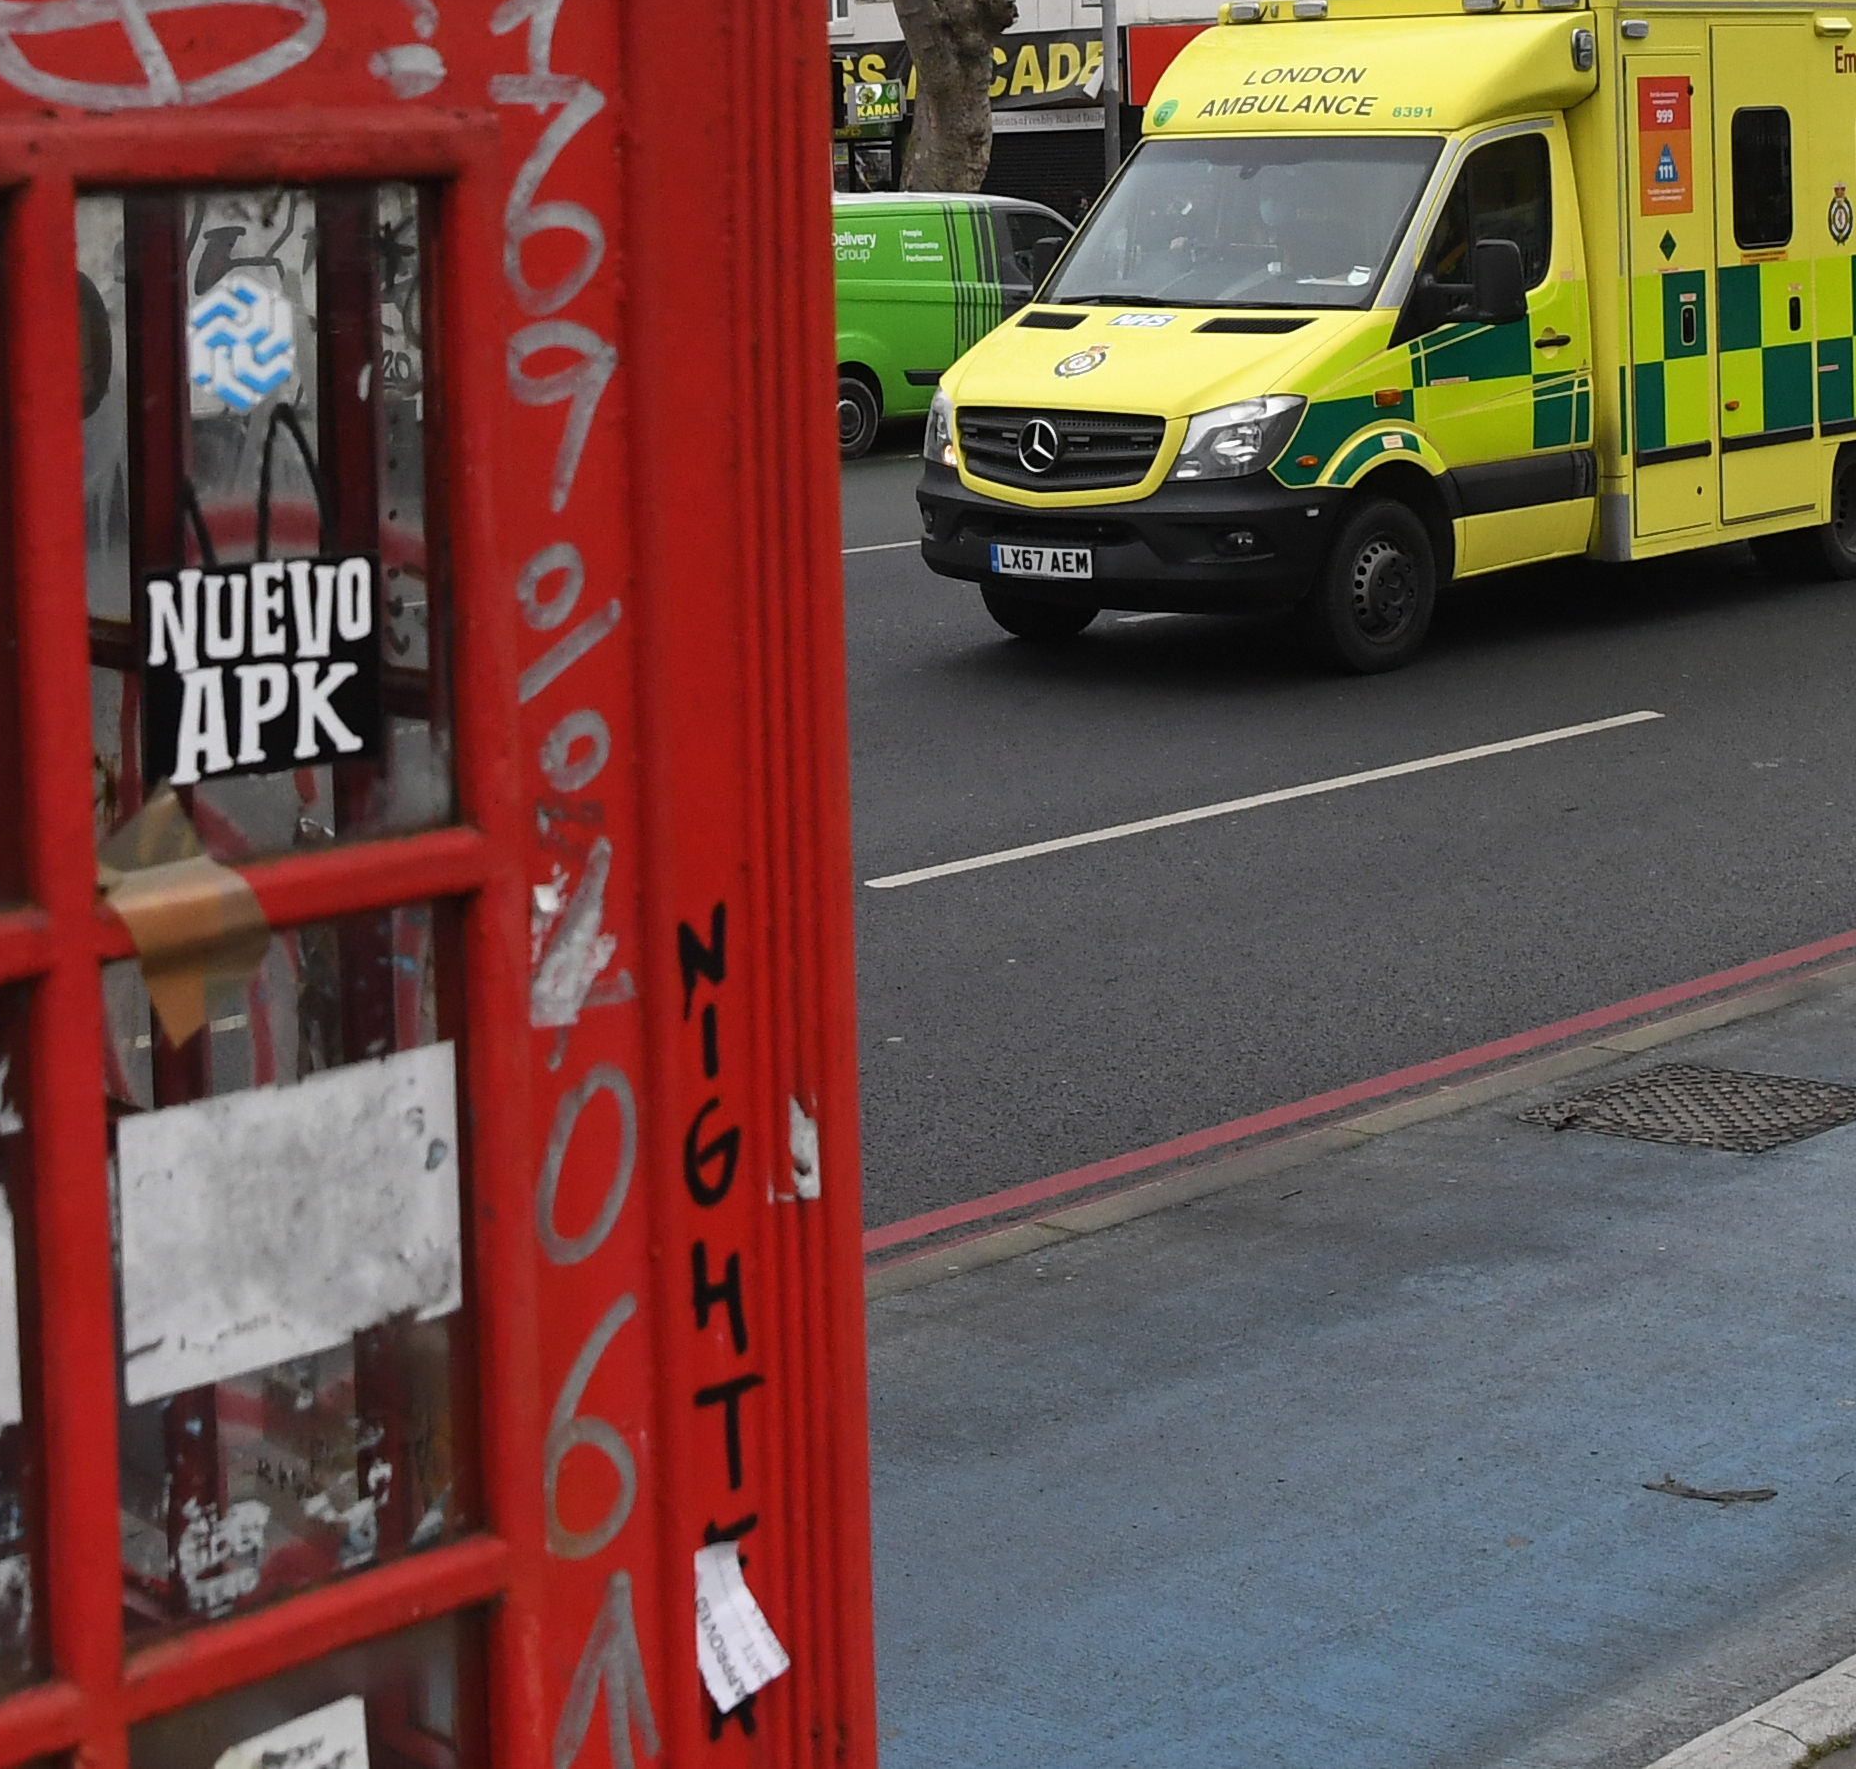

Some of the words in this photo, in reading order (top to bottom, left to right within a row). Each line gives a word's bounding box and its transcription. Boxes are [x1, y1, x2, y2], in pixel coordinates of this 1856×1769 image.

[1242, 66, 1367, 86] LONDON
[857, 102, 899, 118] KARAK
[1196, 94, 1378, 119] AMBULANCE
[1392, 105, 1434, 119] 8391
[1655, 109, 1674, 124] 999
[1658, 164, 1674, 180] 111
[831, 231, 877, 249] Delivery
[835, 246, 871, 264] Group
[1110, 314, 1175, 327] NHS
[1000, 548, 1044, 572] LX67
[1050, 549, 1089, 573] AEM
[146, 556, 372, 673] NUEVO
[169, 661, 364, 786] APK
